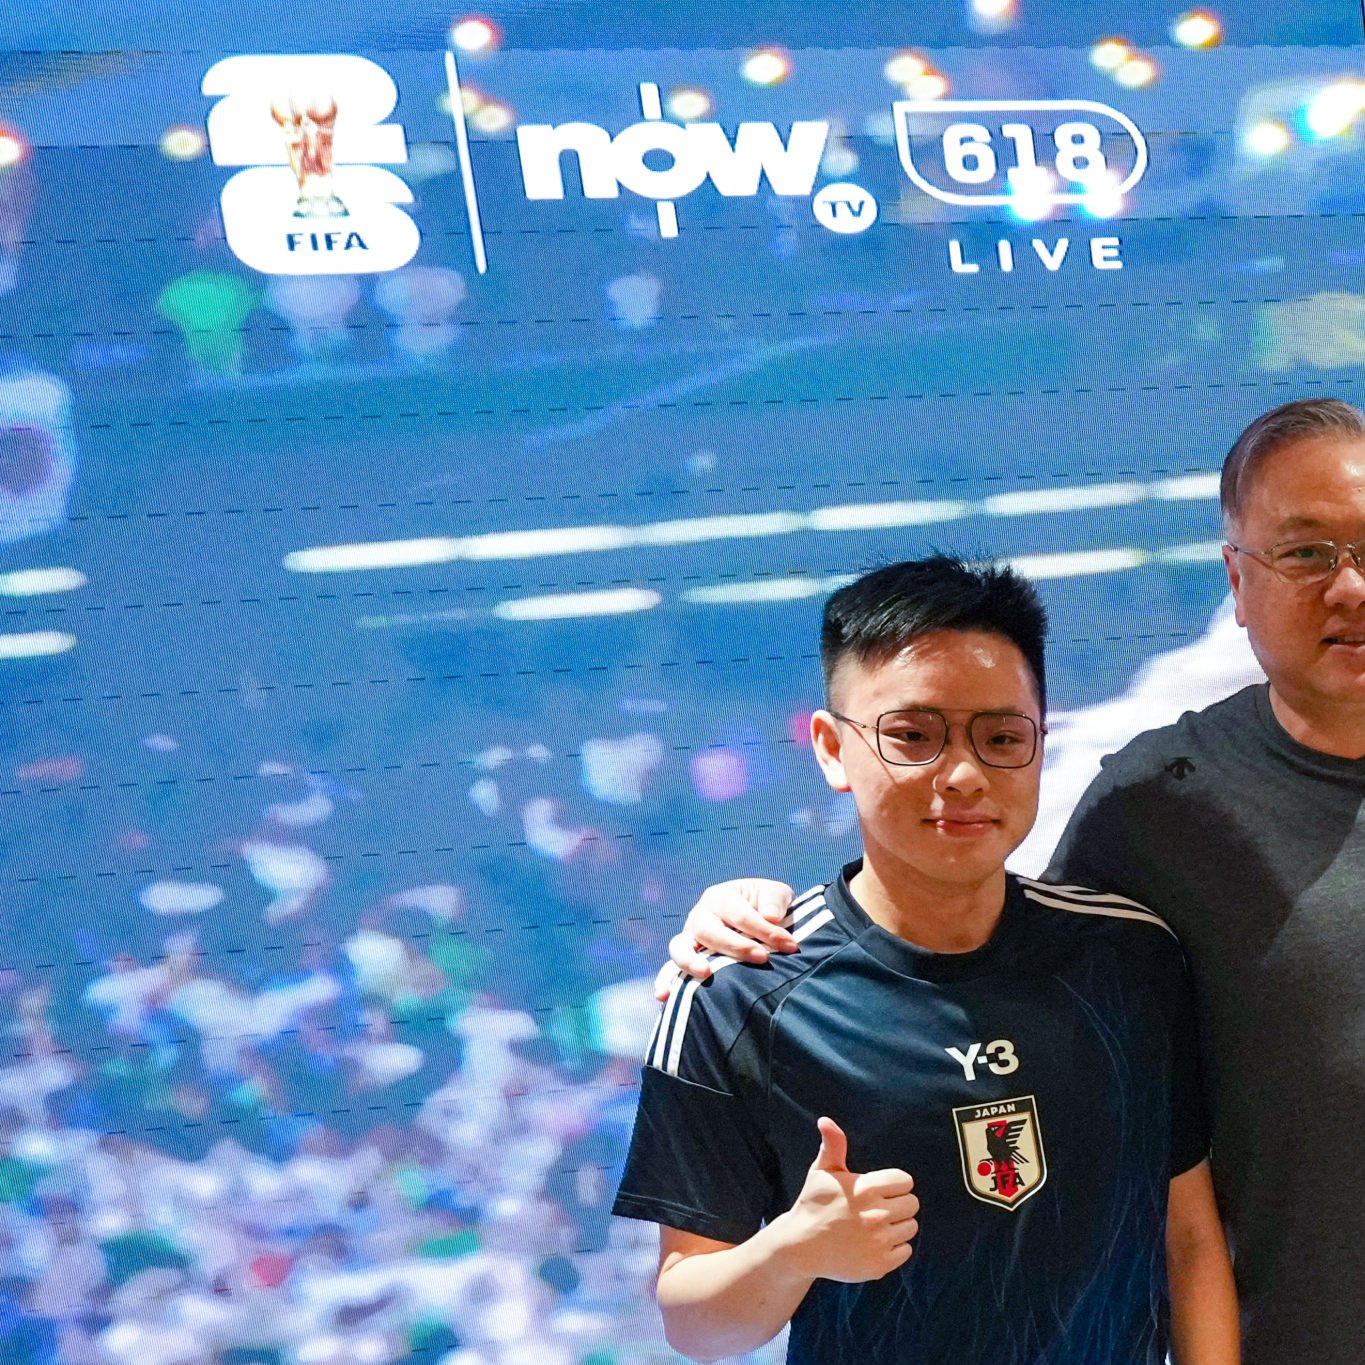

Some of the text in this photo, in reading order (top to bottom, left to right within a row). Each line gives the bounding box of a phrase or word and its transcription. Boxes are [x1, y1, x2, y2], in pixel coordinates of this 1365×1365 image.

[516, 82, 865, 237] now TV
[942, 122, 1108, 189] 618
[286, 232, 370, 251] FIFA
[949, 237, 1123, 273] LIVE
[944, 1039, 1020, 1081] Y-3
[974, 1103, 1017, 1119] JAPAN
[989, 1174, 1025, 1192] JFA
